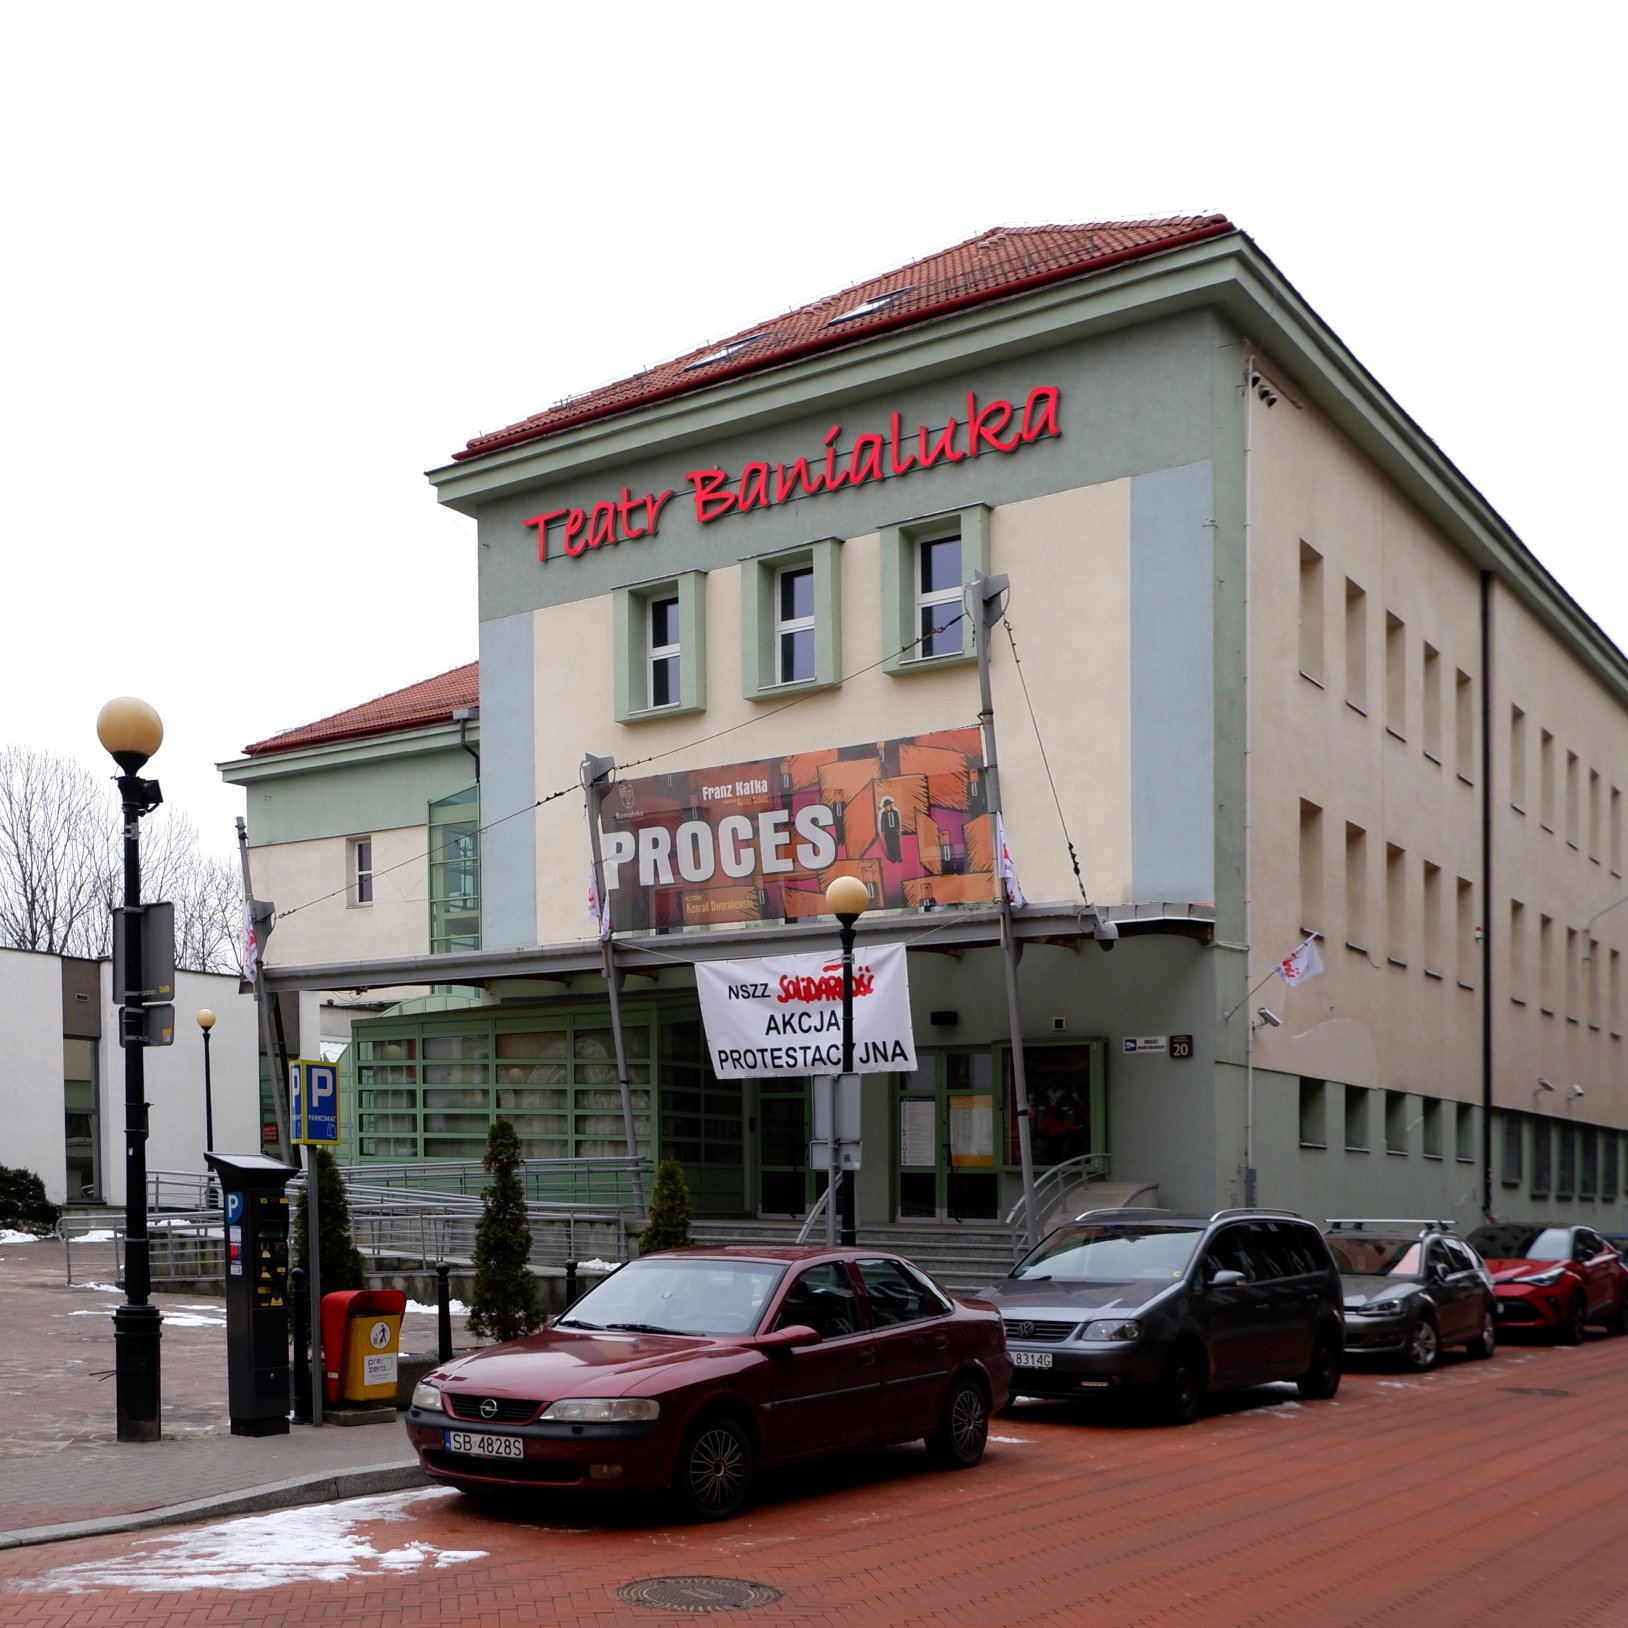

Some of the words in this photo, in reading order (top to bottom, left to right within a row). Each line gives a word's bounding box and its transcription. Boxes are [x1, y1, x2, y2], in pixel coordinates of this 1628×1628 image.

[523, 486, 676, 563] Teatr
[684, 384, 1062, 524] Banialuka
[702, 786, 733, 801] Franz
[735, 779, 769, 797] Kafka
[602, 804, 836, 890] PROCES
[686, 901, 710, 914] Konrad
[728, 983, 771, 1000] NSZZ
[765, 1009, 841, 1036] AKCJA
[1173, 1043, 1189, 1056] 20
[311, 1067, 333, 1107] P
[308, 1114, 337, 1122] PARKOMAT
[227, 1194, 239, 1218] P
[368, 1358, 381, 1367] pre
[368, 1365, 387, 1374] zero
[1016, 1353, 1051, 1367] 8314G
[453, 1433, 473, 1451] SB
[478, 1435, 522, 1457] 4828S
